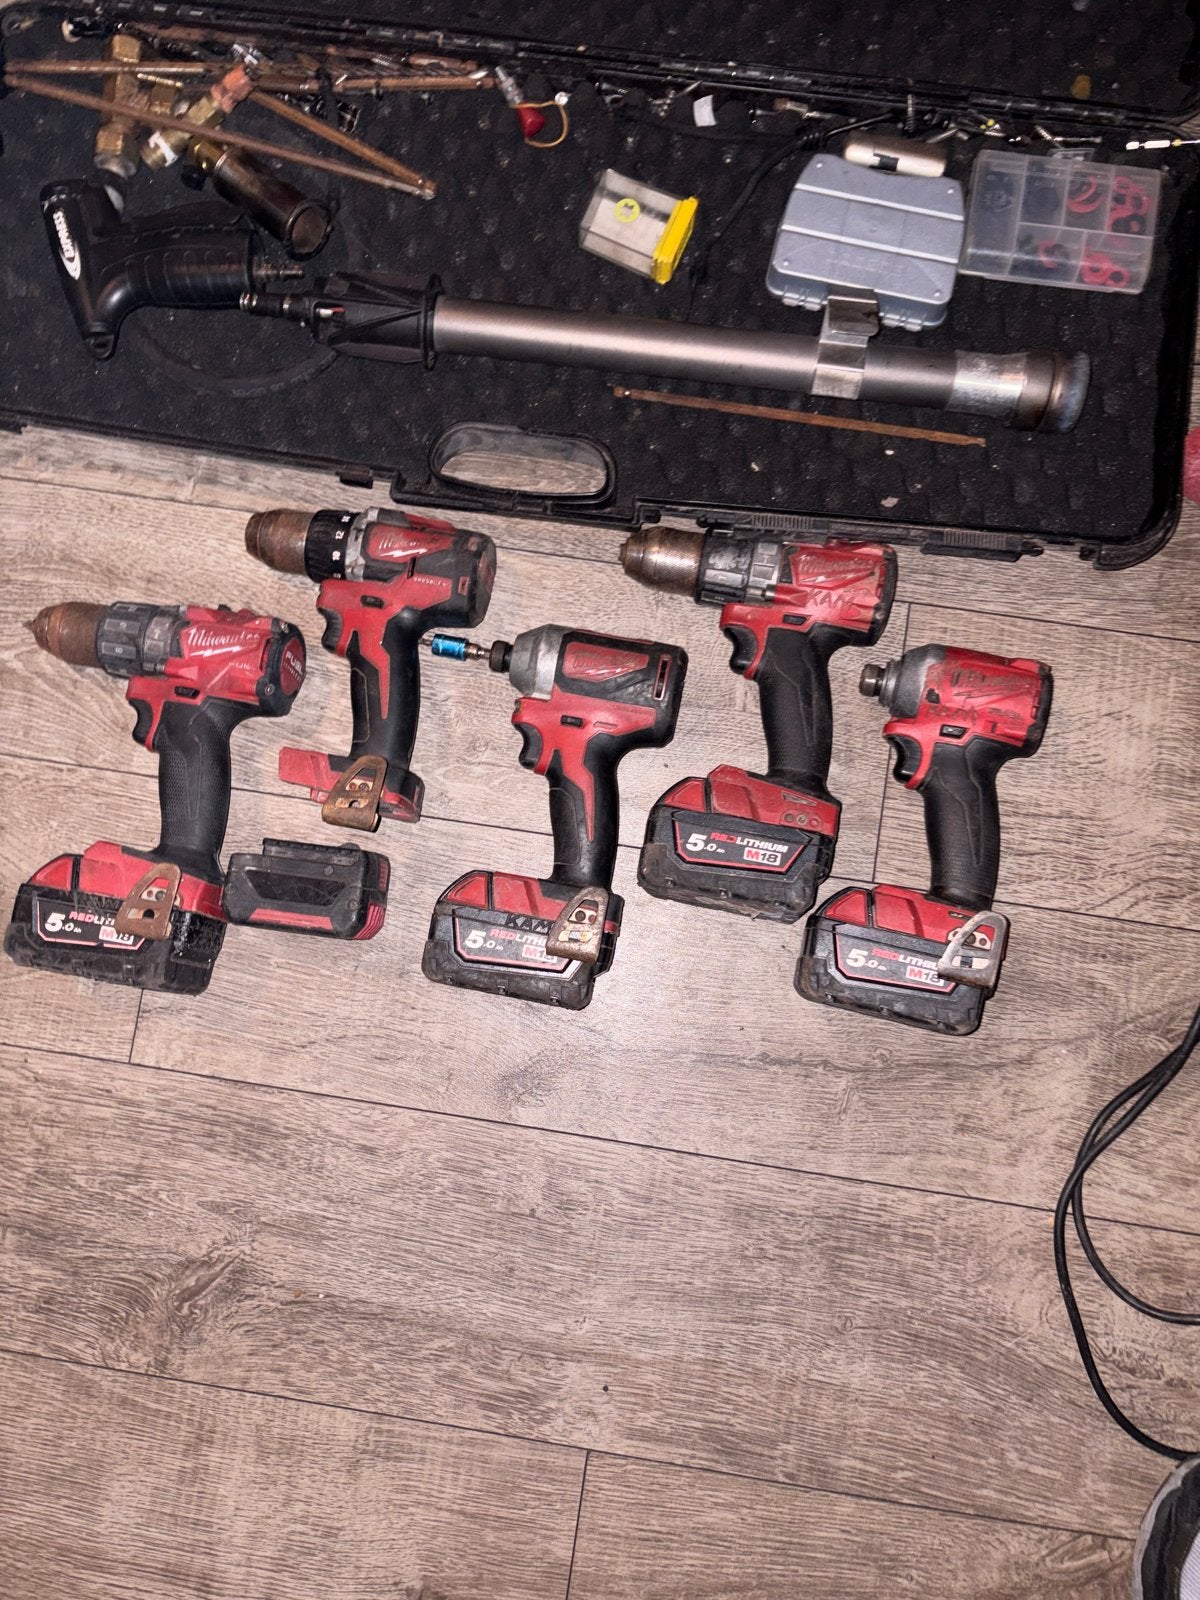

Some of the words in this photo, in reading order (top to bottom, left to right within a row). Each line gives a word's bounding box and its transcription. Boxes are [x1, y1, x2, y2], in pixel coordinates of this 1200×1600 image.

[335, 530, 345, 539] 12
[285, 650, 304, 676] FUEL
[710, 832, 789, 853] REDLITHIUM
[745, 849, 779, 863] M18
[489, 928, 548, 947] REDLITHI
[908, 967, 942, 983] M18
